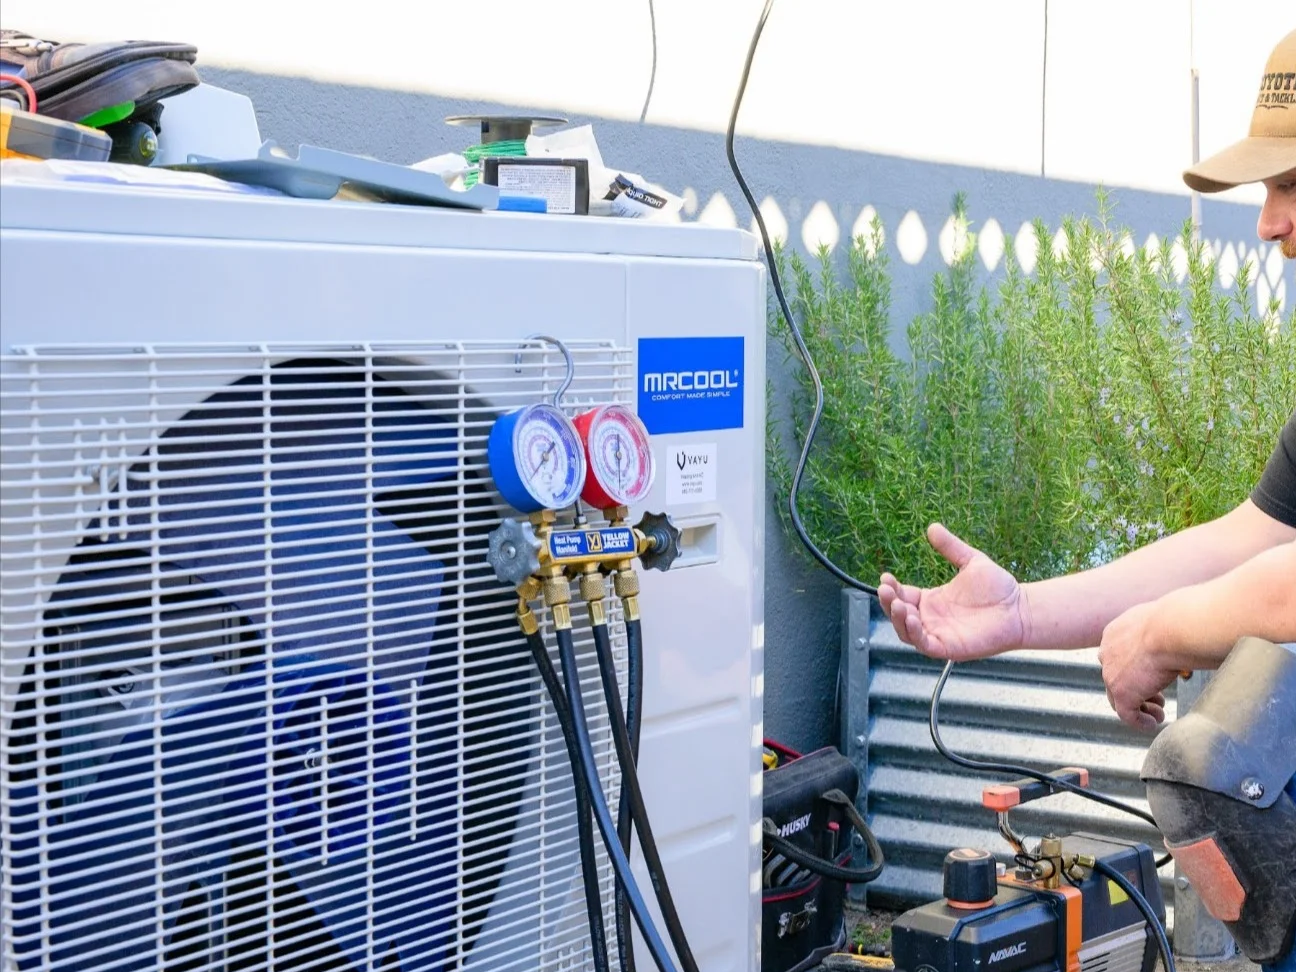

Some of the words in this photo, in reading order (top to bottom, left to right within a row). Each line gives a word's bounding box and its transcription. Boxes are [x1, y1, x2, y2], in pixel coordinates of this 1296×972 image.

[651, 393, 685, 401] COMFORT
[686, 391, 705, 399] MADE
[706, 390, 731, 398] SIMPLE
[688, 455, 709, 465] VAYU
[601, 531, 630, 541] YELLOW
[602, 539, 629, 549] JACKET
[781, 812, 812, 838] HUSKY
[988, 941, 1027, 965] NAVAC
